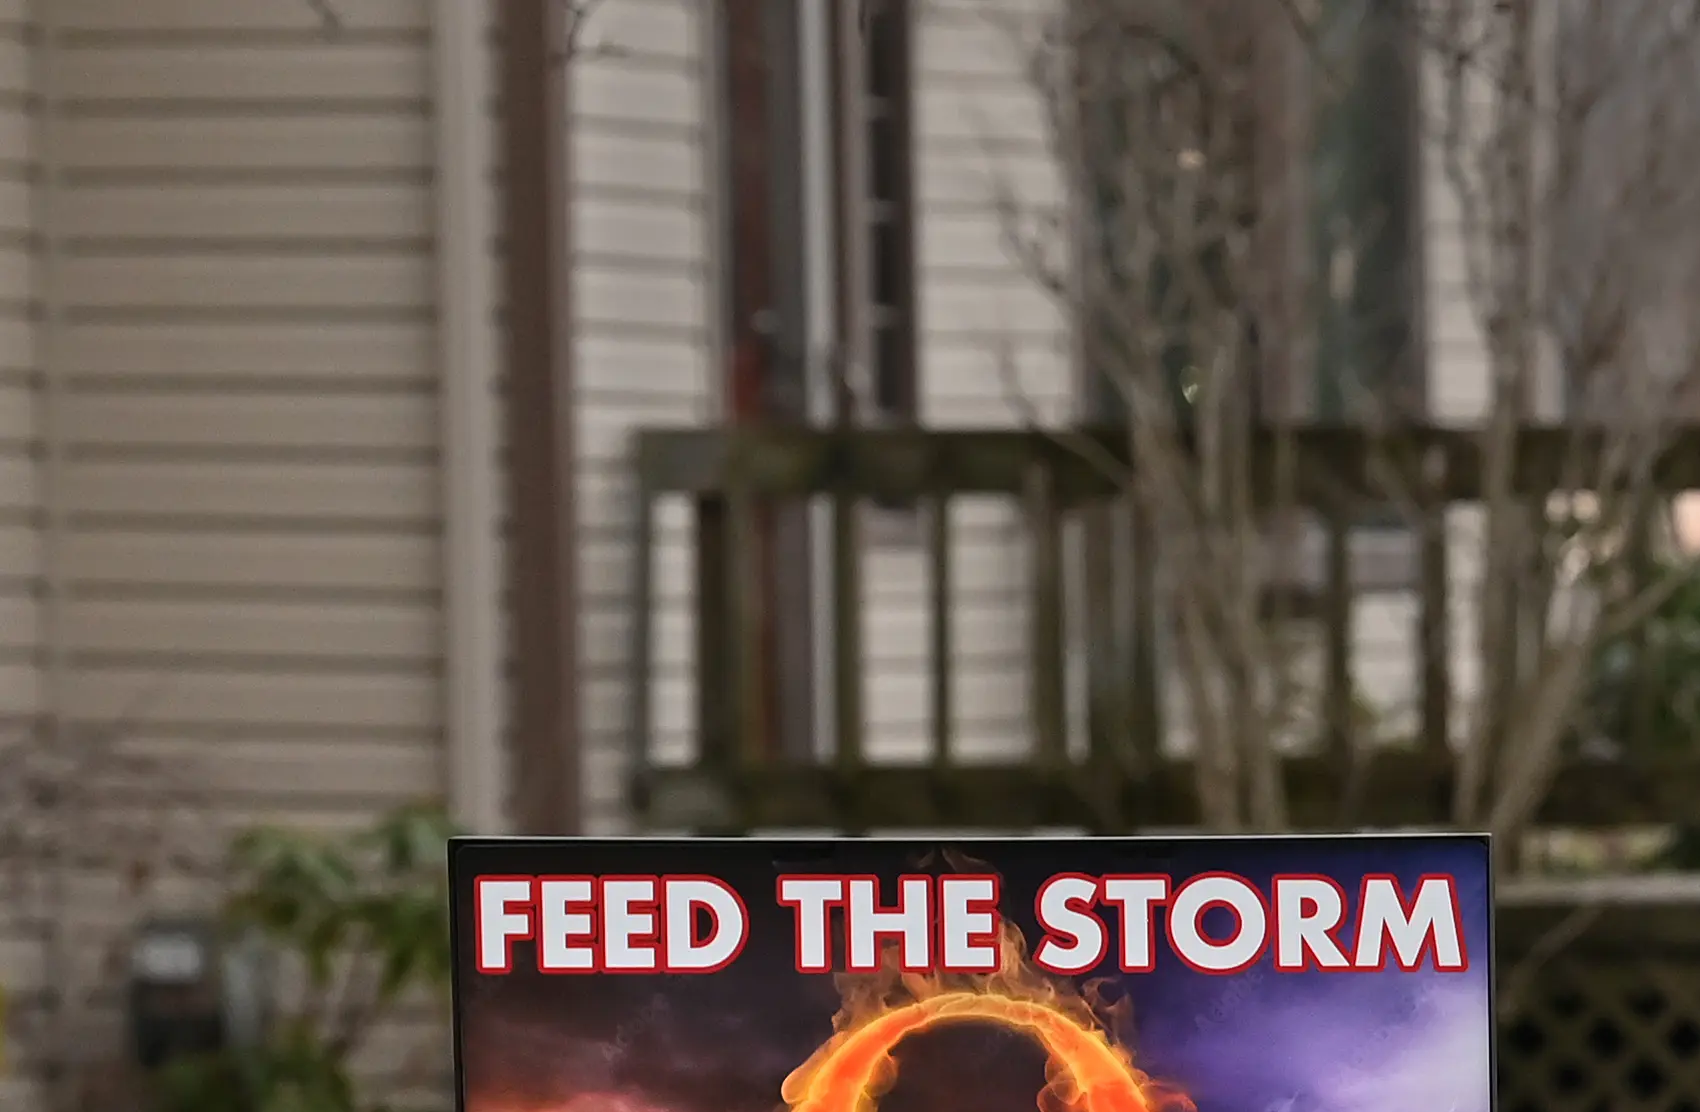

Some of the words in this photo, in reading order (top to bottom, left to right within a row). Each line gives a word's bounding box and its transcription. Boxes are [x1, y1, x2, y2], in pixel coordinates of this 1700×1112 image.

[475, 876, 747, 973] FEED
[778, 875, 1000, 972] THE
[1034, 873, 1467, 974] STORM
